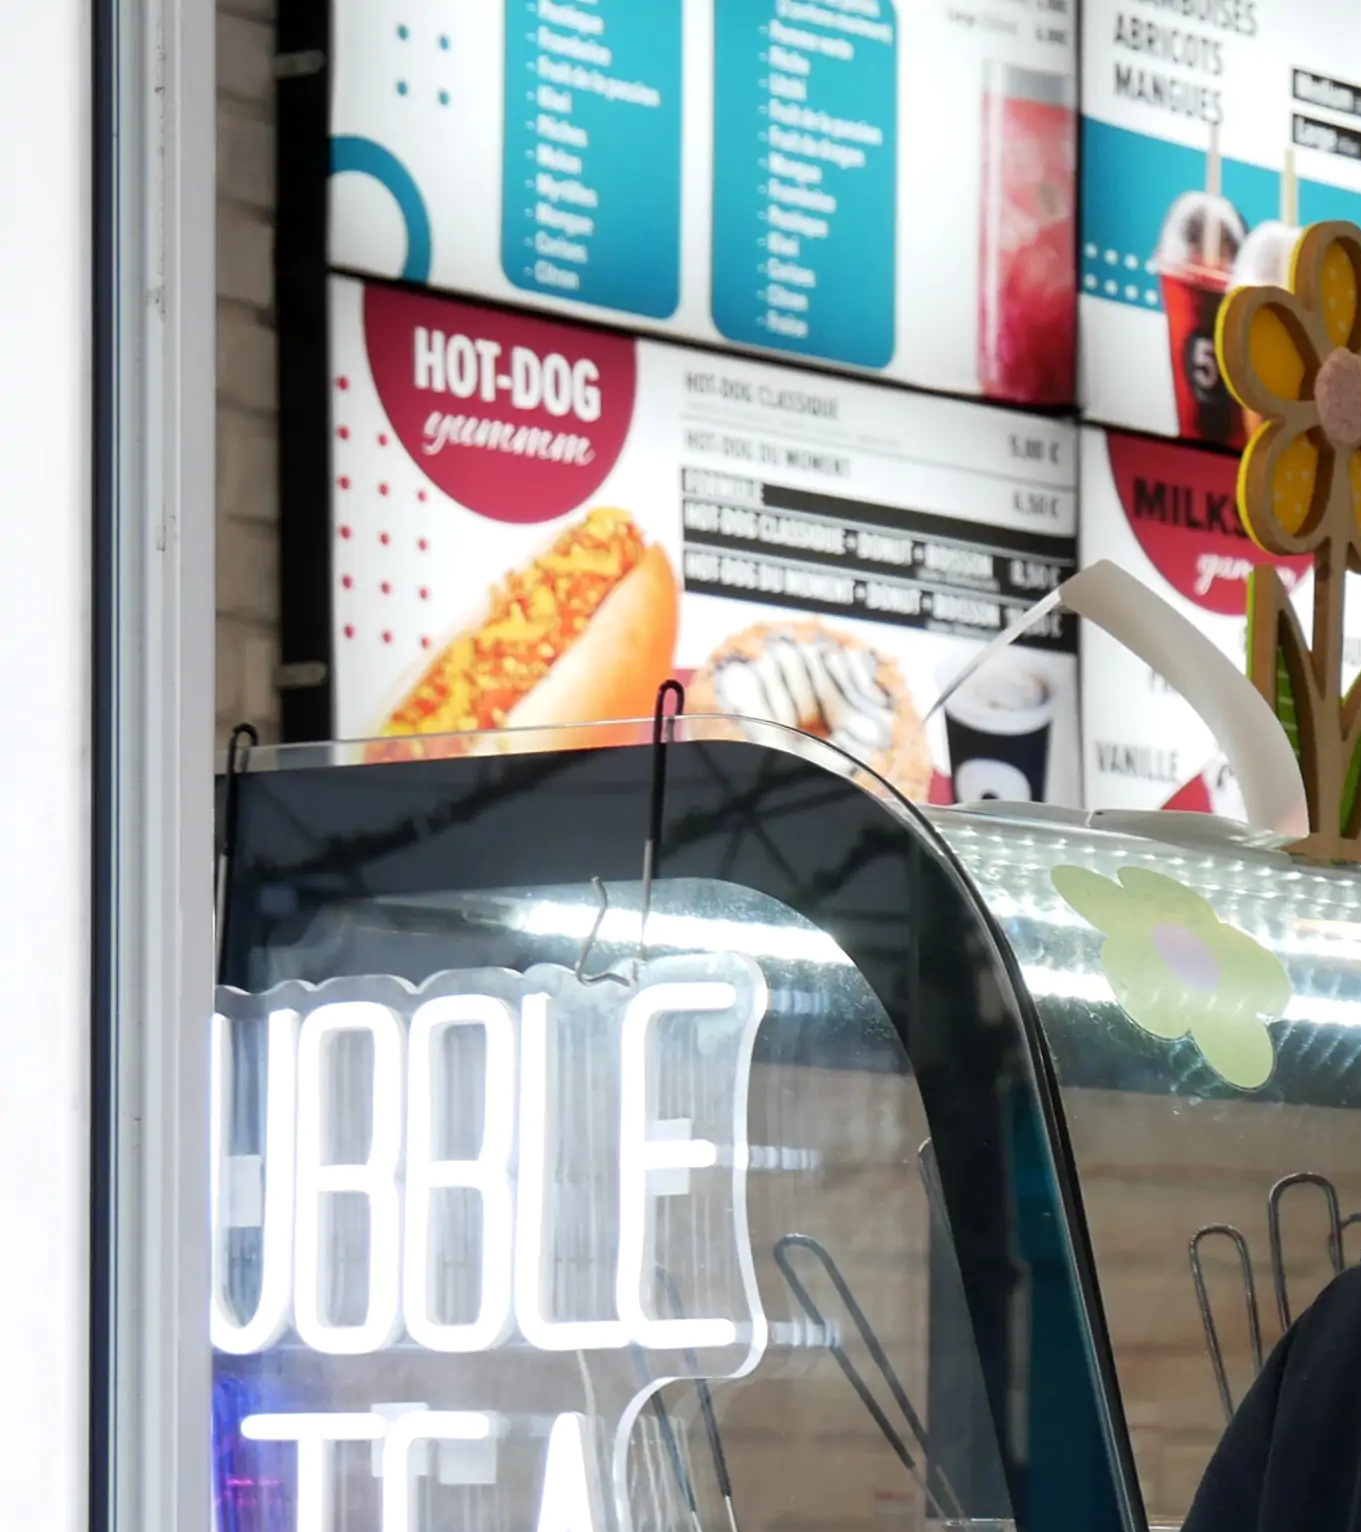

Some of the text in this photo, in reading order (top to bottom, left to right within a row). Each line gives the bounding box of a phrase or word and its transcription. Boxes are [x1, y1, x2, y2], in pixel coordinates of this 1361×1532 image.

[1113, 11, 1225, 78] ABRICOTS
[1113, 60, 1225, 126] MANGUES
[414, 325, 602, 423] HOT-DOG
